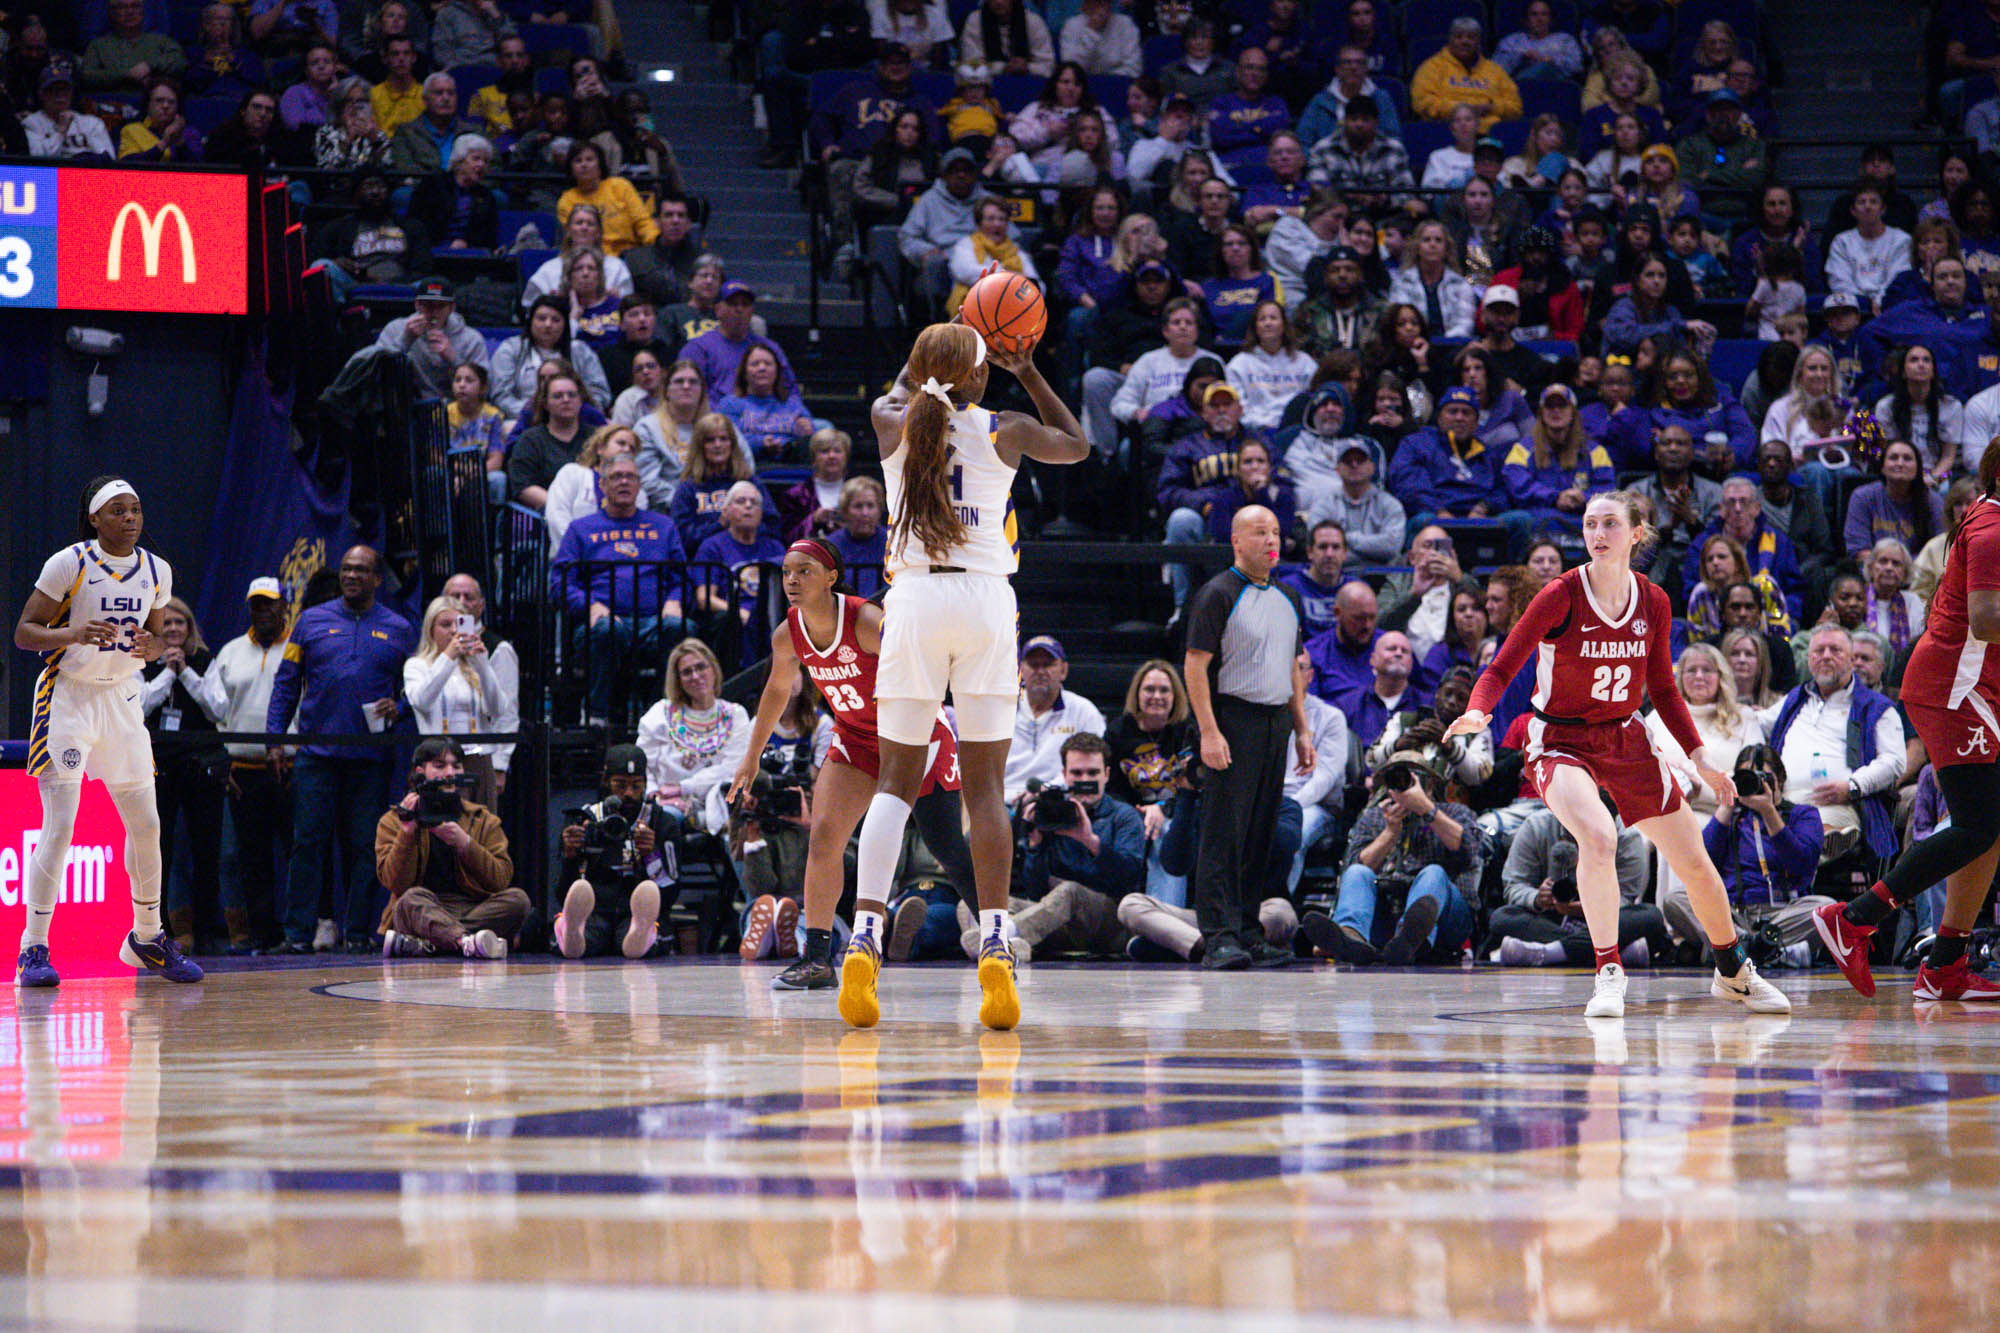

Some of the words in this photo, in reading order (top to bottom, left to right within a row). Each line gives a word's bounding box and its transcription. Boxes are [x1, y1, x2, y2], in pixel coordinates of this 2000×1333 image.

[589, 529, 660, 544] TIGERS
[101, 597, 142, 612] LSU
[1579, 640, 1647, 659] ALABAMA
[807, 662, 863, 681] ALABAMA
[1590, 664, 1632, 702] 22
[824, 684, 866, 712] 23
